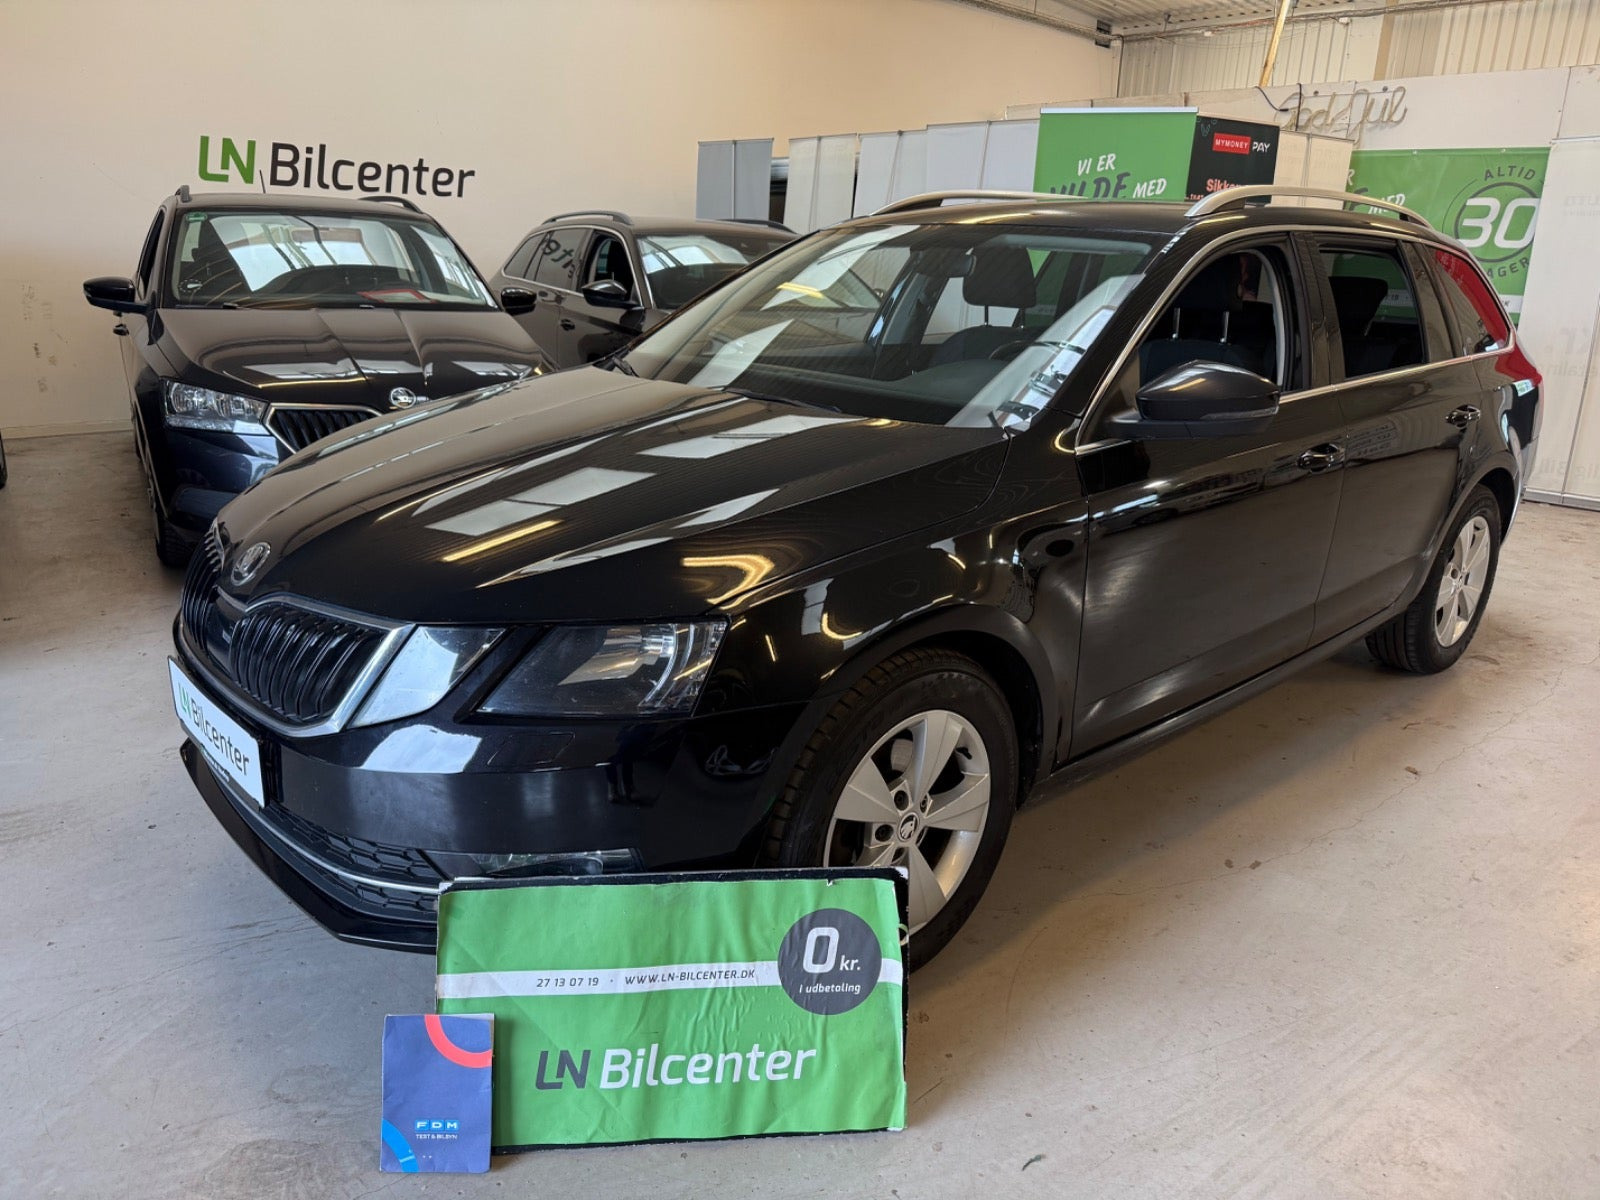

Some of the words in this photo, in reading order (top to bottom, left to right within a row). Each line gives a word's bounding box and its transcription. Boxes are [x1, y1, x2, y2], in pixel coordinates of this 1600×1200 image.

[1214, 138, 1249, 150] MYMONEY
[1252, 141, 1271, 153] PAY
[198, 135, 257, 184] LN
[269, 141, 476, 198] Bilcenter
[1077, 157, 1093, 177] VI
[1096, 152, 1117, 172] ER
[1483, 165, 1536, 181] ALTID
[1133, 177, 1168, 199] MED
[1457, 197, 1540, 249] 30
[178, 682, 192, 720] LN
[190, 697, 250, 776] Bilcenter
[802, 926, 840, 974] 0
[839, 954, 861, 972] kr.
[536, 977, 550, 988] 27
[554, 977, 566, 987] 13
[569, 977, 583, 987] 07
[587, 976, 599, 986] 19
[625, 968, 755, 985] WWW.LN-BILCENTER.DK
[805, 982, 861, 995] udbetaling
[535, 1049, 592, 1091] LN
[598, 1042, 817, 1090] Bilcenter
[416, 1121, 458, 1129] FDM
